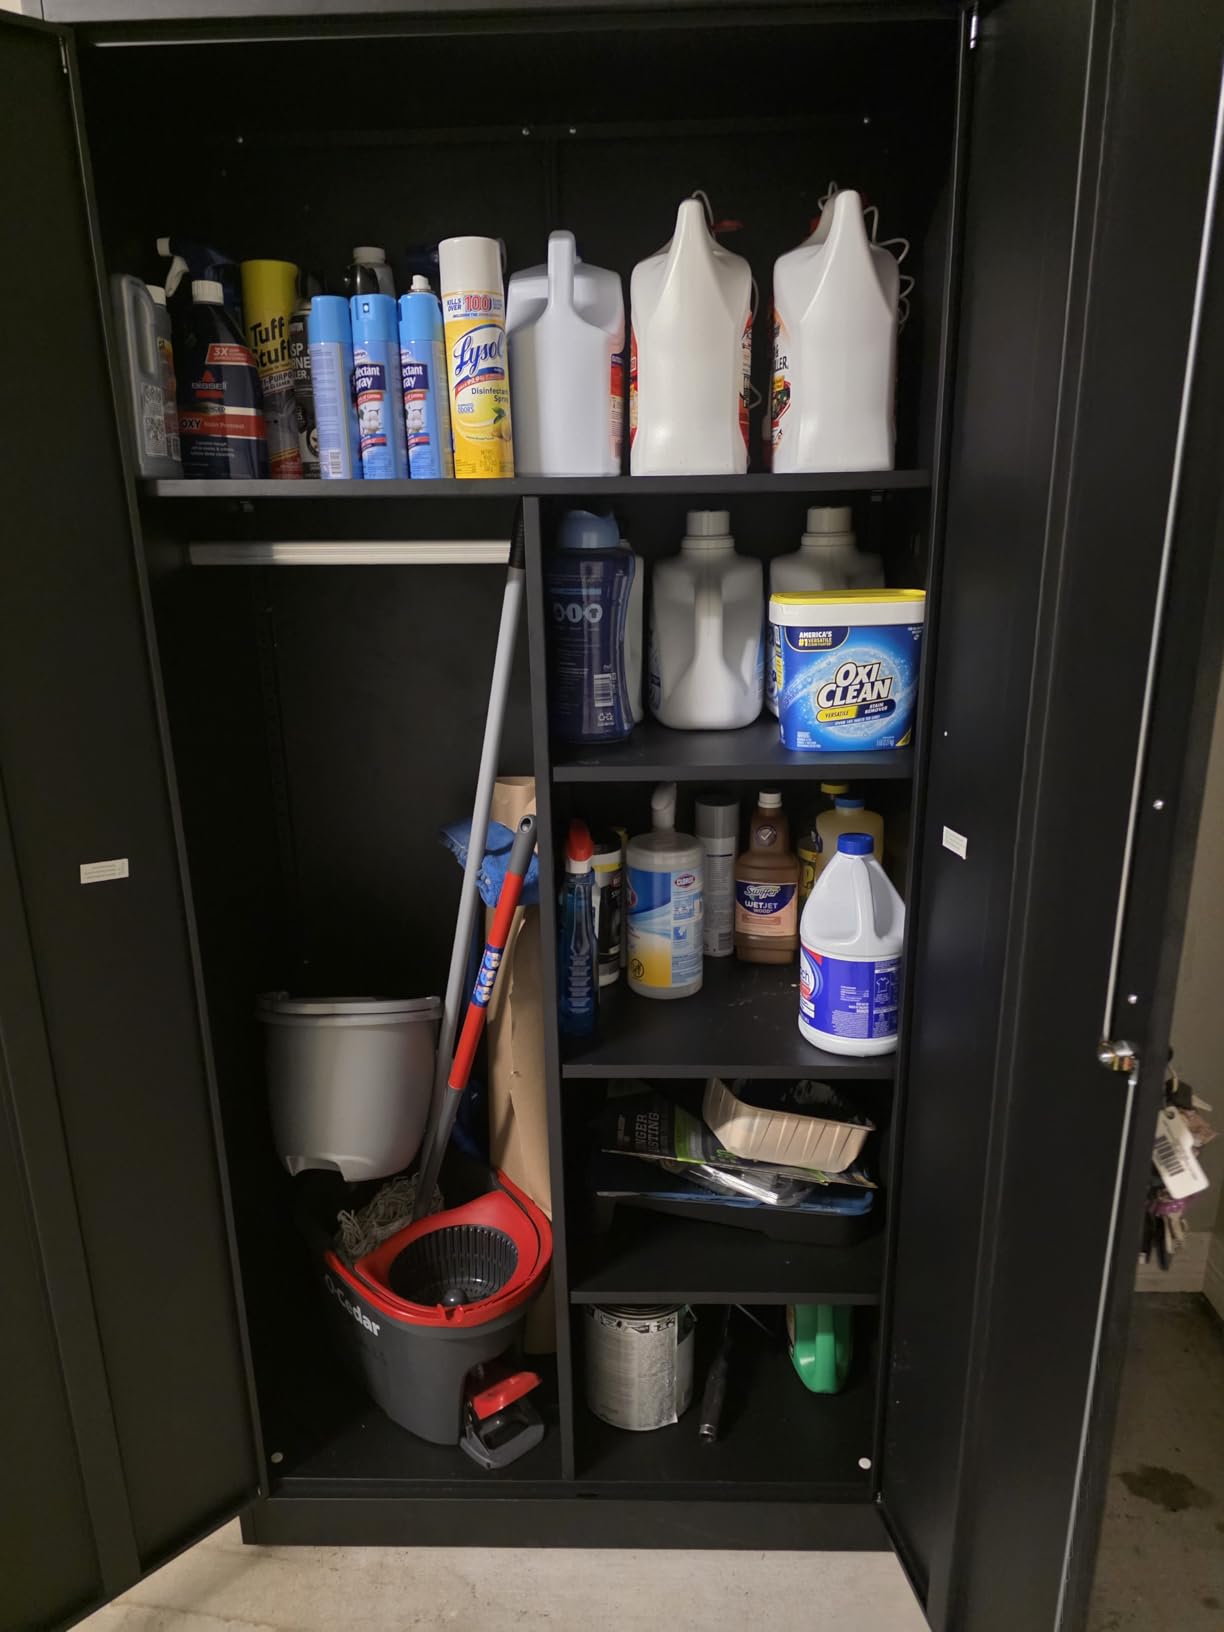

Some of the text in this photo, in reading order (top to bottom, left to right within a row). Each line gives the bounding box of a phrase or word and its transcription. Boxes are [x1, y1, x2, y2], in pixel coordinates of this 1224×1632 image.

[465, 294, 492, 312] 100
[250, 316, 285, 347] Tuff
[290, 342, 304, 357] SP
[453, 332, 504, 376] Lysol
[402, 366, 423, 377] ectant
[403, 376, 416, 389] ray
[835, 662, 881, 688] OXI
[817, 677, 893, 708] CLEAN
[825, 710, 849, 718] VERSATILE
[744, 885, 781, 899] Swiffer
[744, 900, 779, 909] WETJET
